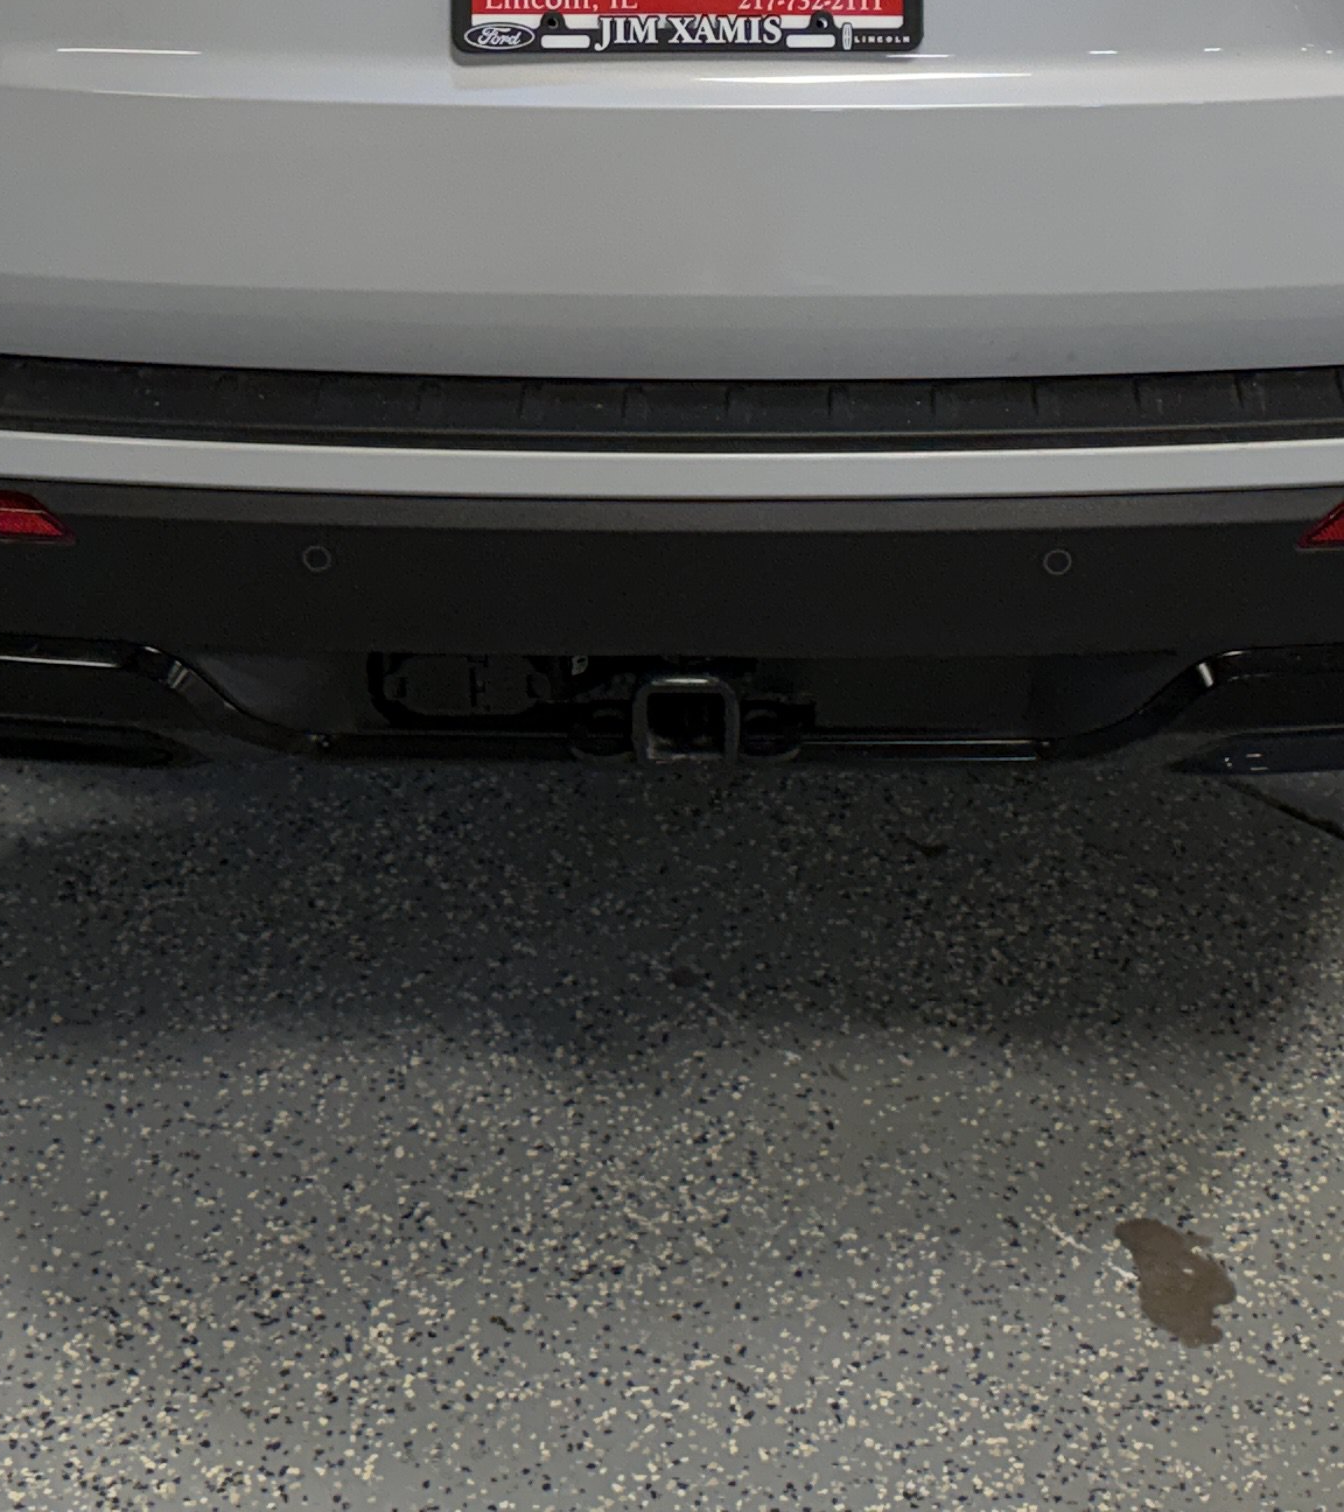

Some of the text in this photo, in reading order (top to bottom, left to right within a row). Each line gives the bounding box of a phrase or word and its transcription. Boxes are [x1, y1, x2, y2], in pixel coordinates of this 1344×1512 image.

[477, 26, 523, 46] Ford
[595, 16, 783, 51] JIM XAMIS
